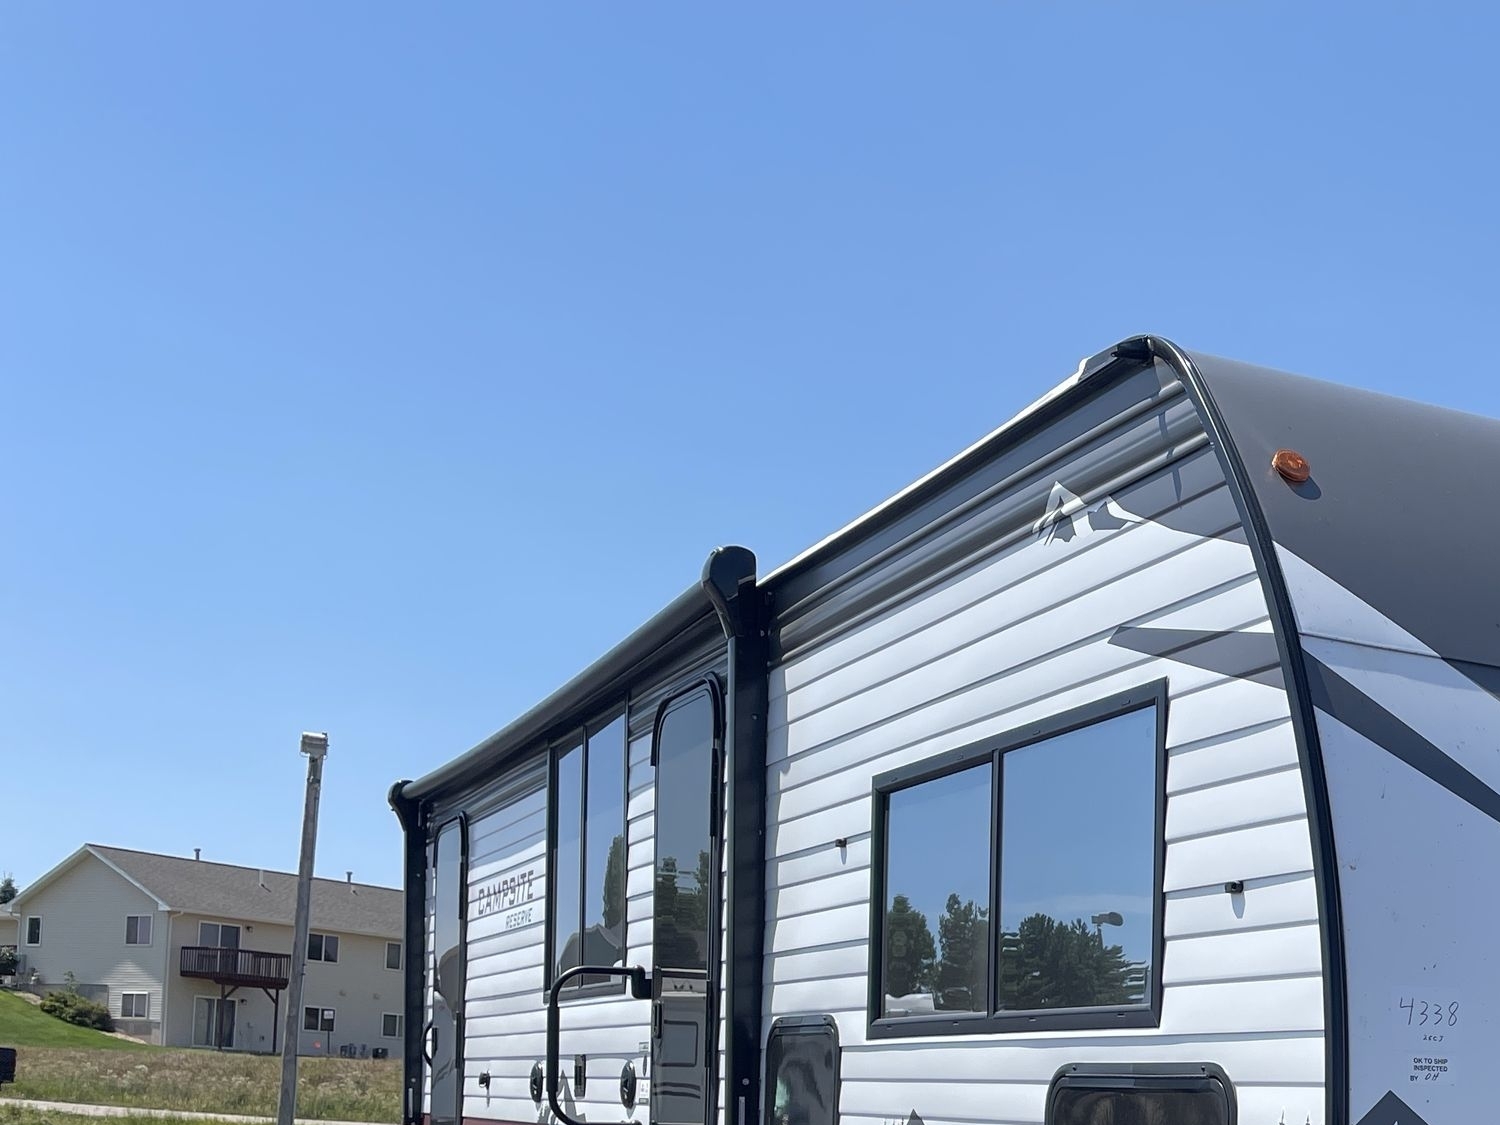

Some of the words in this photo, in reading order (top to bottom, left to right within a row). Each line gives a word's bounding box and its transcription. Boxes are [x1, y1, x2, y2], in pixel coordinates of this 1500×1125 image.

[478, 869, 534, 915] CAMPSITE
[505, 907, 533, 929] RESERVE
[1399, 997, 1460, 1027] 4338
[1413, 1064, 1449, 1072] INSPECTED
[1424, 1057, 1433, 1065] TO
